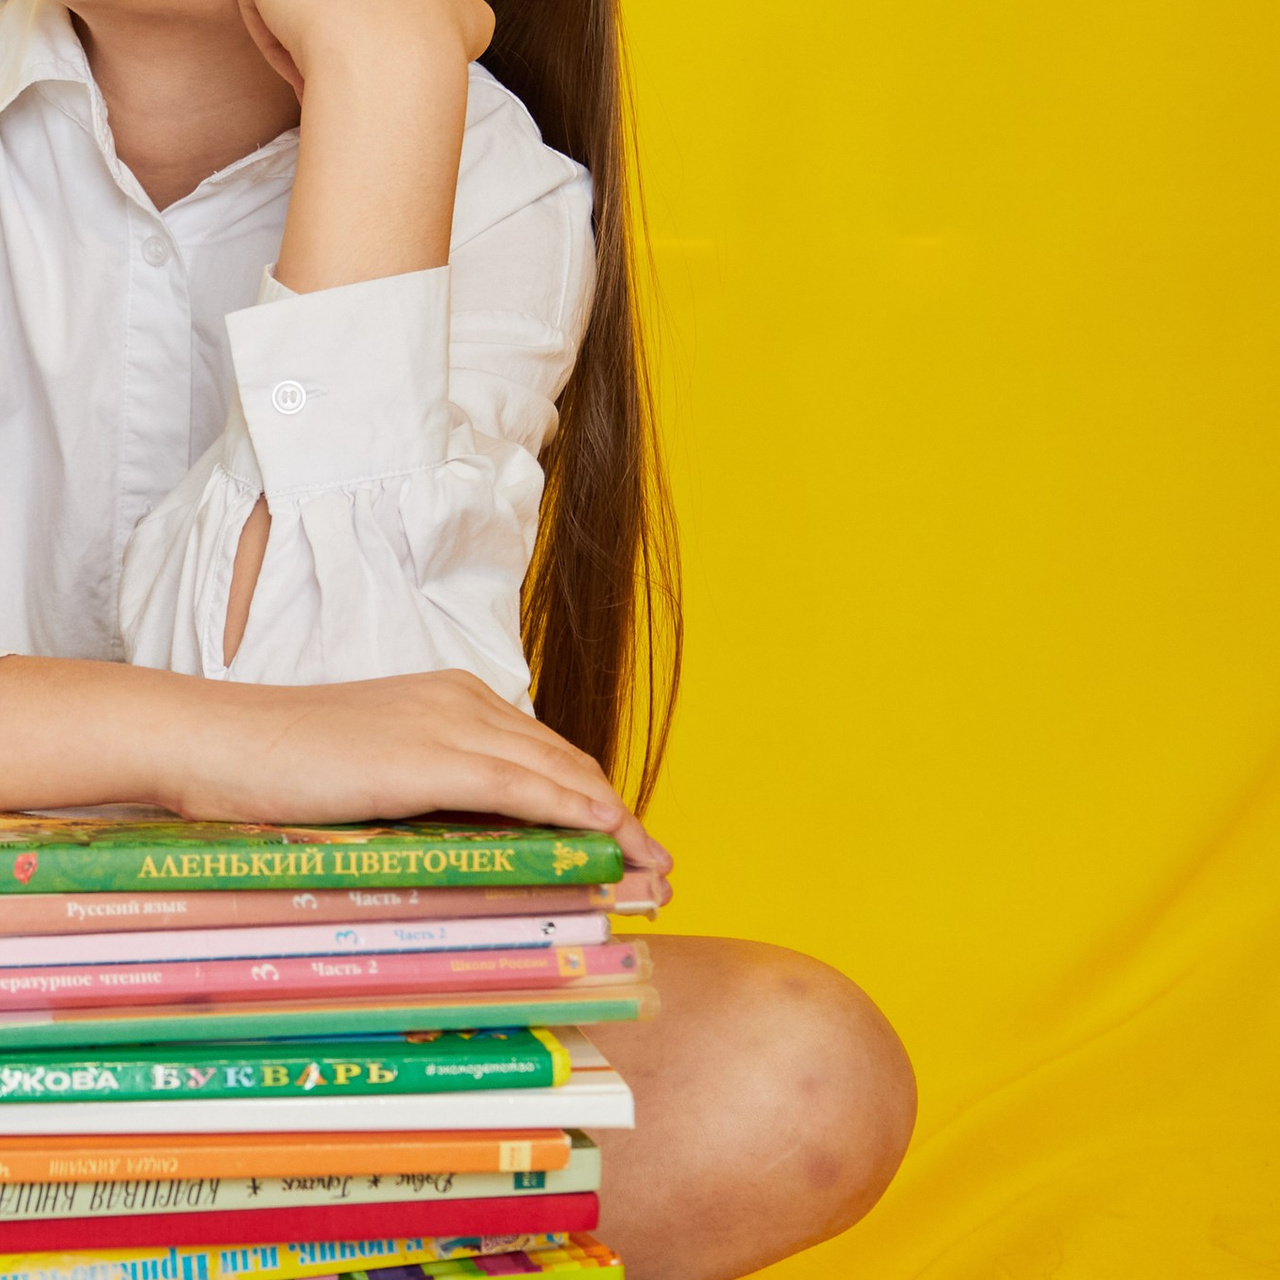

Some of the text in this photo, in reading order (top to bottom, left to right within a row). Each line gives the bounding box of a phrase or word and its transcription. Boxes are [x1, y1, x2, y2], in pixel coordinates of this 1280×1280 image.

[138, 846, 515, 879] АЛЕНЬКИЙ ЦВЕТОЧЕК
[350, 889, 419, 907] Часть 2
[66, 899, 188, 920] Русский язык
[394, 927, 447, 941] Часть 2
[99, 969, 163, 986] чтение
[311, 959, 379, 977] Часть 2
[152, 1061, 398, 1091] БУКВАРЬ
[89, 1178, 220, 1212] КРАСИВАЯ
